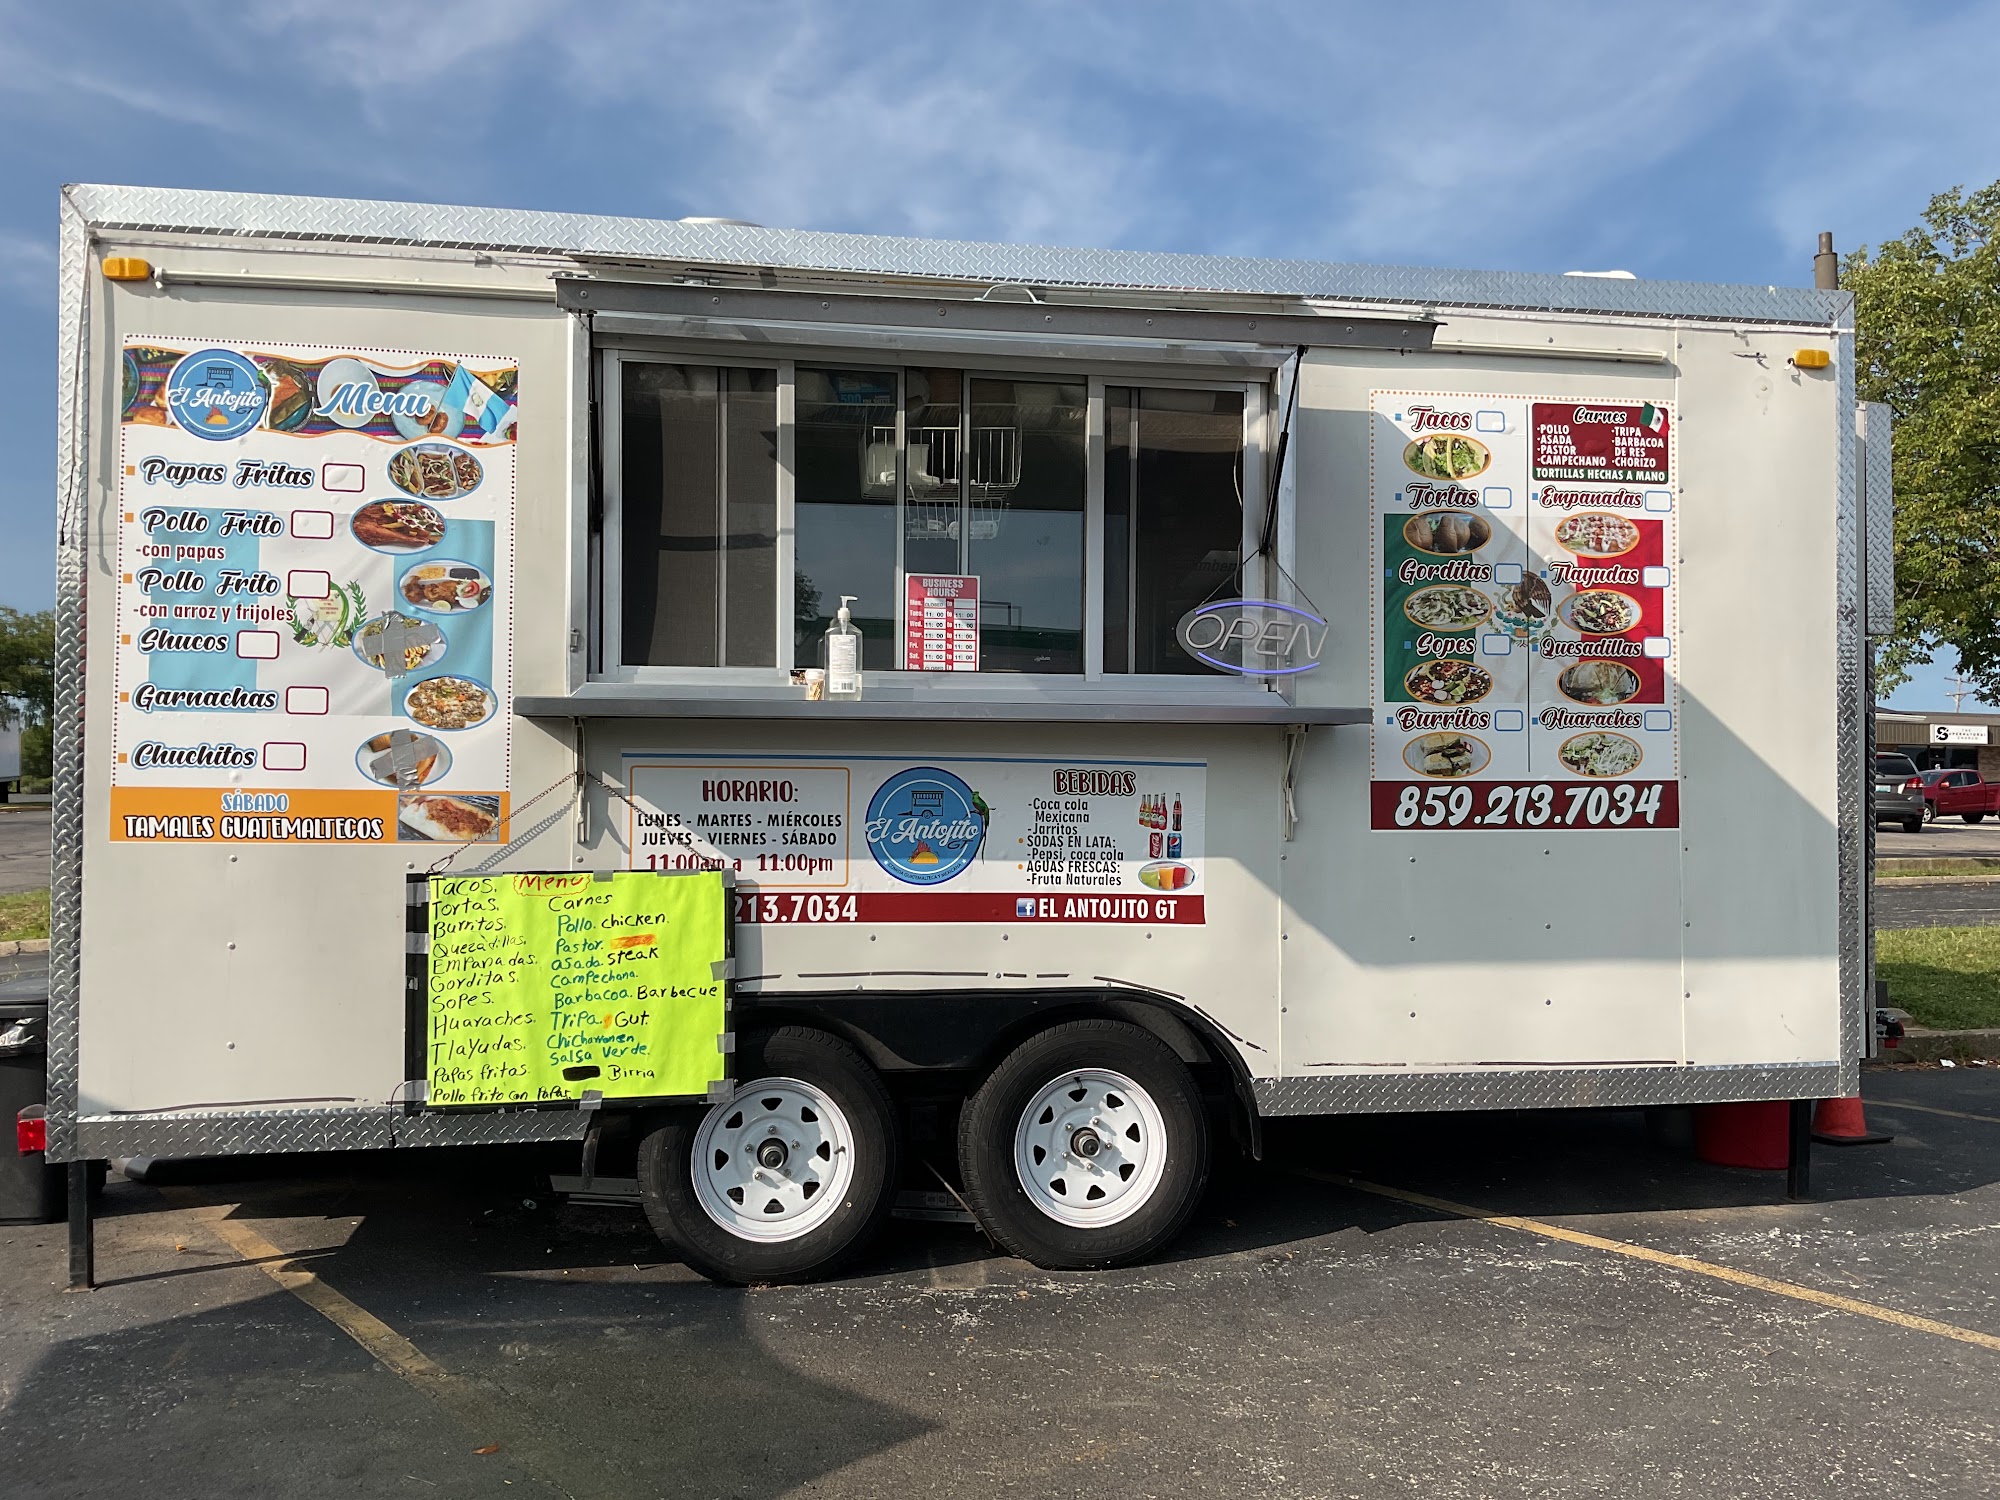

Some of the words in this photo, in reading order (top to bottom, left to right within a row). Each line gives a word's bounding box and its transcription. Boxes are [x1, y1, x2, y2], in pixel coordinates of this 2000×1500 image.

[168, 387, 191, 406] El
[189, 388, 262, 411] Antojito
[314, 382, 430, 417] Menu
[1409, 406, 1472, 430] Tacos
[1574, 406, 1627, 424] Carnes
[1540, 424, 1570, 435] POLLO
[1614, 426, 1642, 437] TRIPA
[1540, 435, 1572, 445] ASADA
[1540, 445, 1576, 455] PASTOR
[1614, 437, 1664, 448] BARBACOA
[1540, 455, 1606, 467] CAMPECHANO
[1614, 447, 1628, 457] DE
[1630, 447, 1646, 458] RES
[1614, 458, 1656, 468] CHORIZO
[141, 459, 225, 488] Papas
[234, 460, 313, 489] Fritas
[1536, 468, 1585, 479] TORTILLAS
[1587, 468, 1624, 480] HECHAS
[1625, 470, 1634, 480] A
[1635, 471, 1666, 482] MANO
[1408, 483, 1479, 508] Tortas
[1541, 485, 1642, 510] Empanadas
[142, 510, 209, 538] Pollo
[220, 512, 283, 538] Frito
[175, 546, 225, 562] papas
[1400, 559, 1492, 586] Gorditas
[1550, 562, 1639, 587] Tlayudas
[137, 569, 205, 595] Pollo
[216, 571, 280, 597] Frito
[922, 578, 963, 588] BUSINESS
[927, 588, 959, 597] HOURS:
[174, 607, 216, 620] arroz
[222, 607, 230, 622] y
[236, 604, 294, 624] frijoles
[140, 628, 228, 653] Shucos
[1186, 613, 1329, 659] OPEN
[1416, 632, 1476, 658] Sopes
[1540, 636, 1642, 658] Quesadillas
[133, 685, 277, 710] Garnachas
[1397, 707, 1490, 731] Burritos
[1540, 709, 1642, 730] Huaraches
[133, 743, 256, 768] Chuchitos
[702, 779, 799, 803] HORARIO:
[1055, 770, 1136, 796] BEBIDAS
[222, 790, 288, 812] SÁBADO
[1064, 799, 1088, 811] cola
[1394, 784, 1663, 827] 859.213.7034
[638, 814, 681, 827] LUNES
[697, 814, 752, 827] MARTES
[767, 811, 842, 827] MIÉRCOLES
[1035, 811, 1090, 823] Mexicana
[124, 816, 214, 838] TAMALES
[221, 817, 384, 840] GUATEMALTECOS
[641, 832, 692, 846] JUEVES
[708, 832, 766, 846] VIERNES
[782, 829, 837, 846] SÁBADO
[865, 818, 893, 843] El
[891, 818, 979, 846] Antojito
[1027, 836, 1064, 848] SODAS
[1068, 836, 1081, 848] EN
[1086, 836, 1116, 849] LATA:
[732, 858, 742, 872] a
[758, 854, 833, 875] 11:00pm
[1070, 850, 1096, 861] coca
[1100, 849, 1124, 861] cola
[1026, 861, 1064, 873] AGUAS
[1068, 861, 1121, 874] FRESCAS:
[519, 875, 584, 891] Menu
[1066, 874, 1122, 886] Naturales
[548, 894, 613, 912] Carnes
[1039, 898, 1058, 918] EL
[1064, 898, 1149, 919] ANTOJITO
[1155, 899, 1177, 920] GT
[607, 1064, 655, 1081] Birria
[433, 1086, 466, 1102] Pollo
[508, 1091, 529, 1100] con
